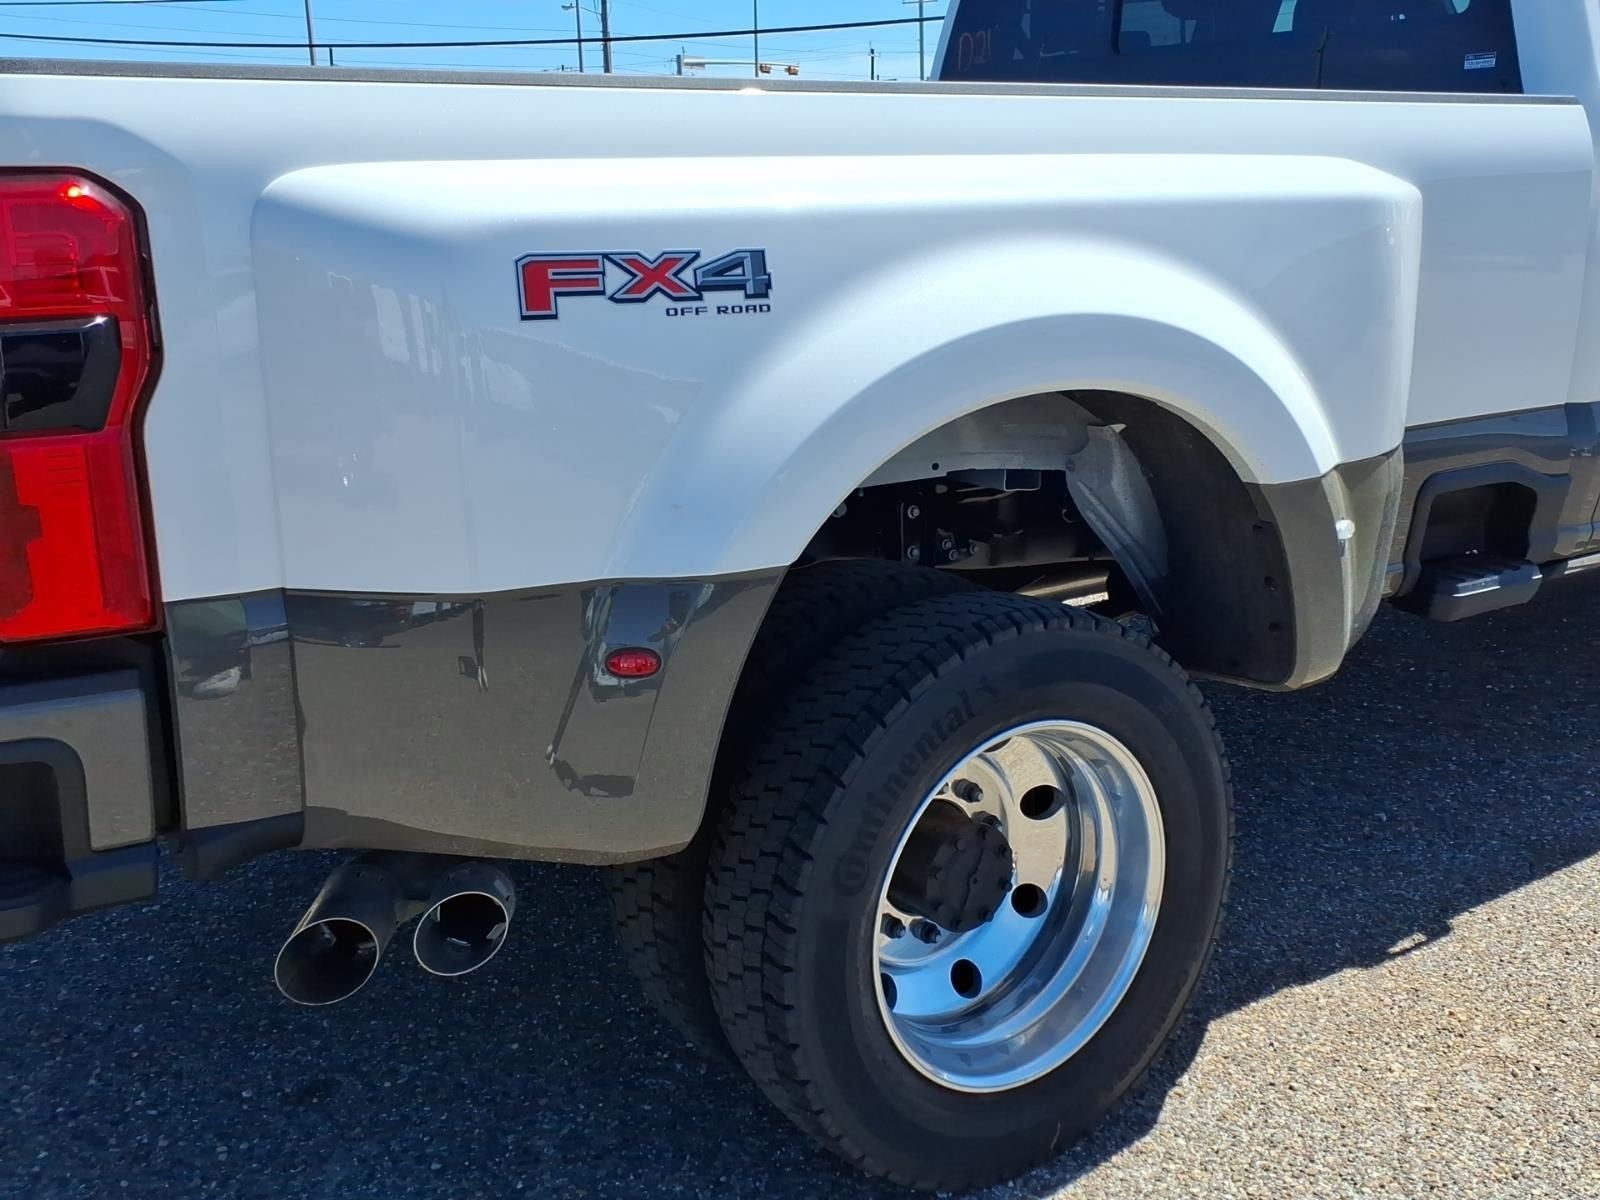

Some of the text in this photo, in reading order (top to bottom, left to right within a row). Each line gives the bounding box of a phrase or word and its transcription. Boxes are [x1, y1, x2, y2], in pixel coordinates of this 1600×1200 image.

[514, 248, 772, 320] FX4
[665, 303, 771, 317] OFF ROAD
